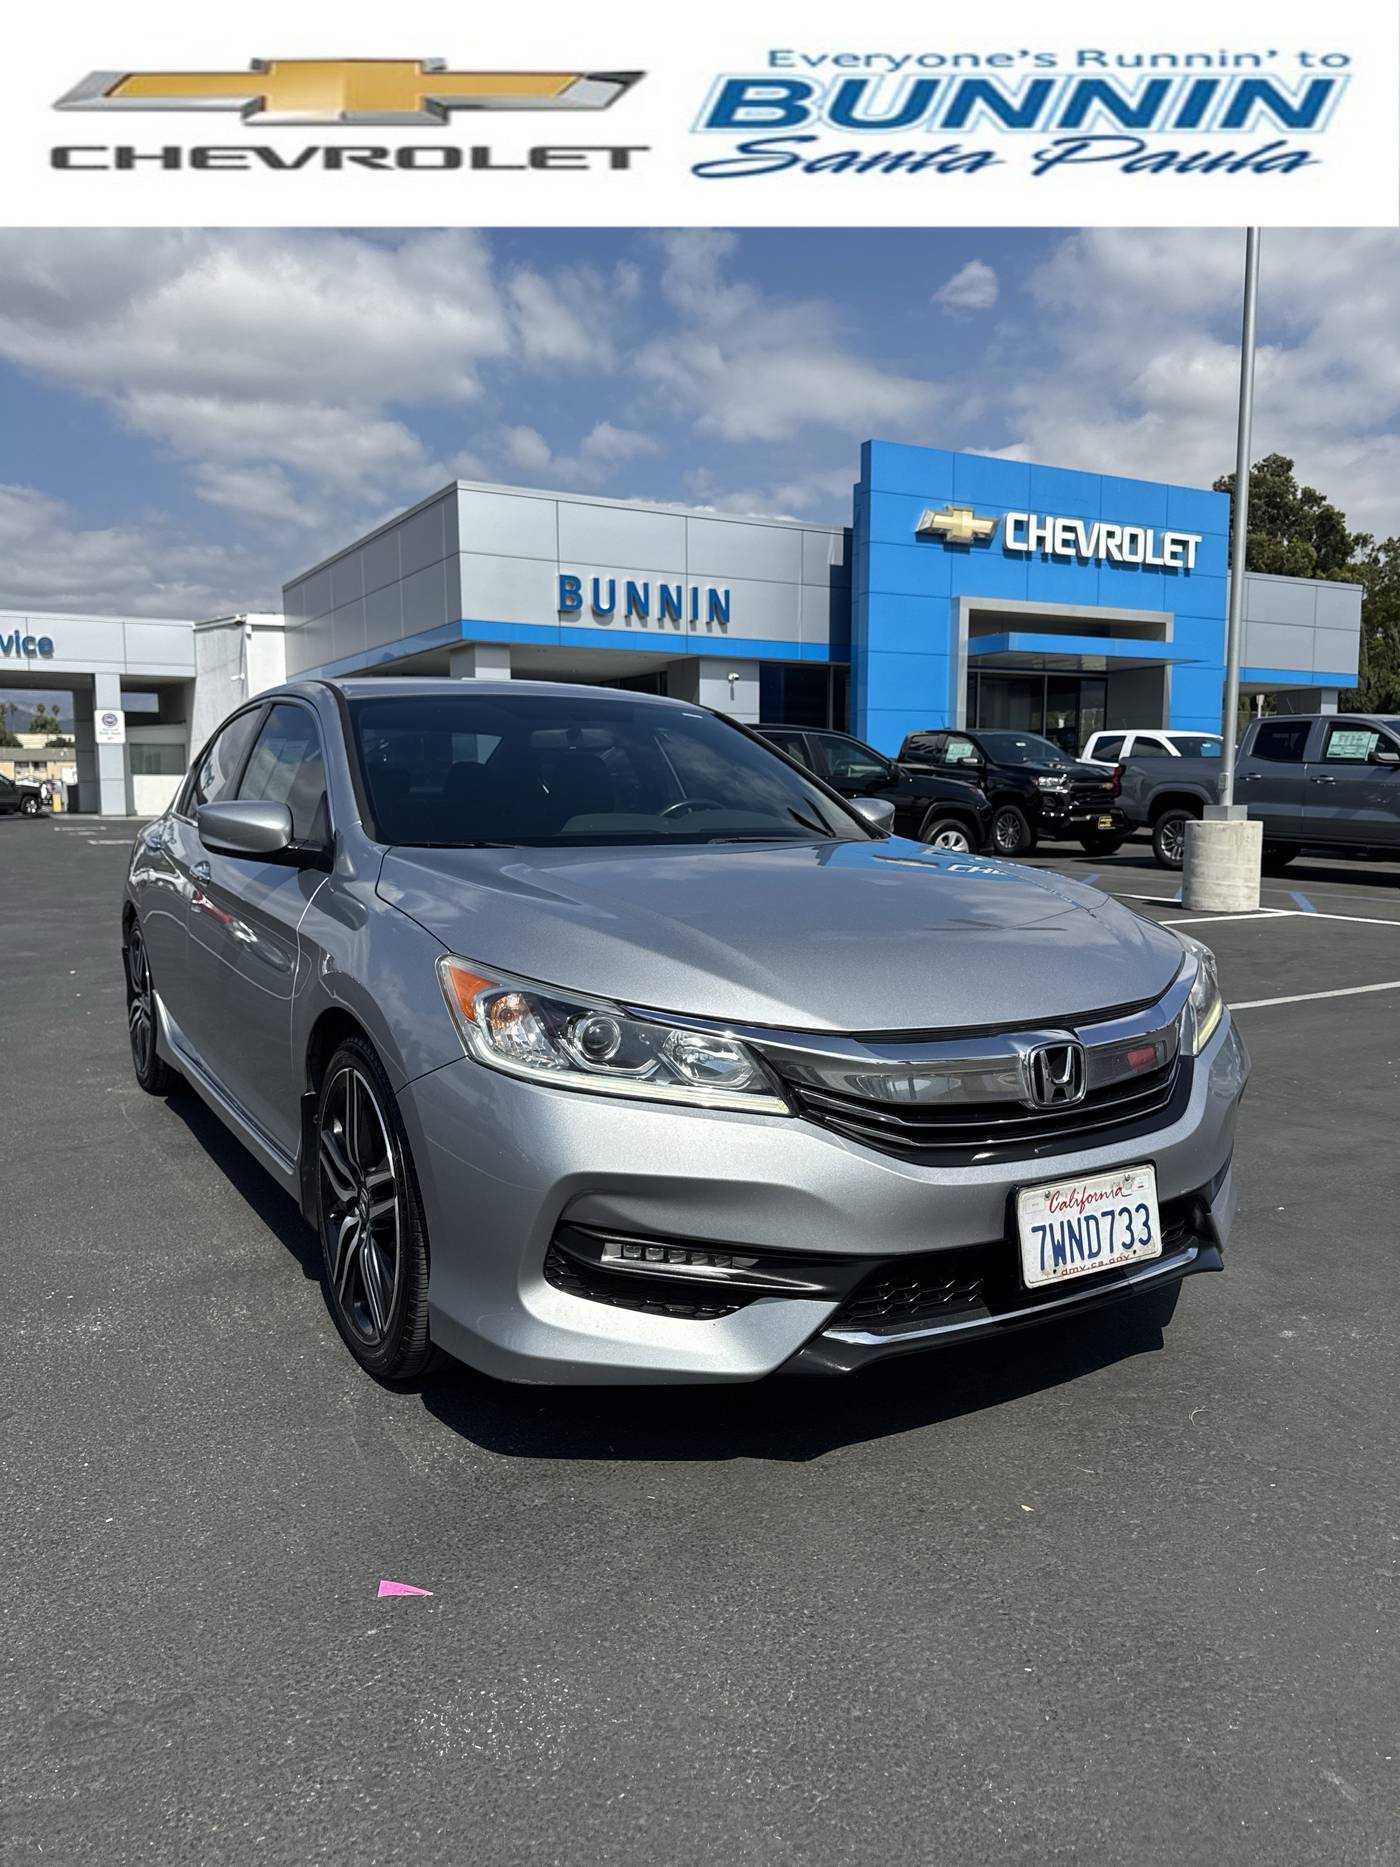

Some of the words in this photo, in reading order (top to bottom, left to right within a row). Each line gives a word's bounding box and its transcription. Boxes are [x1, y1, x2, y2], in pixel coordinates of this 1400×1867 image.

[1005, 512, 1202, 569] CHEVROLET
[558, 574, 731, 624] BUNNIN
[1048, 1185, 1133, 1214] California
[1031, 1203, 1152, 1271] 7WND733
[1061, 1253, 1131, 1276] dmv.ca.gov
